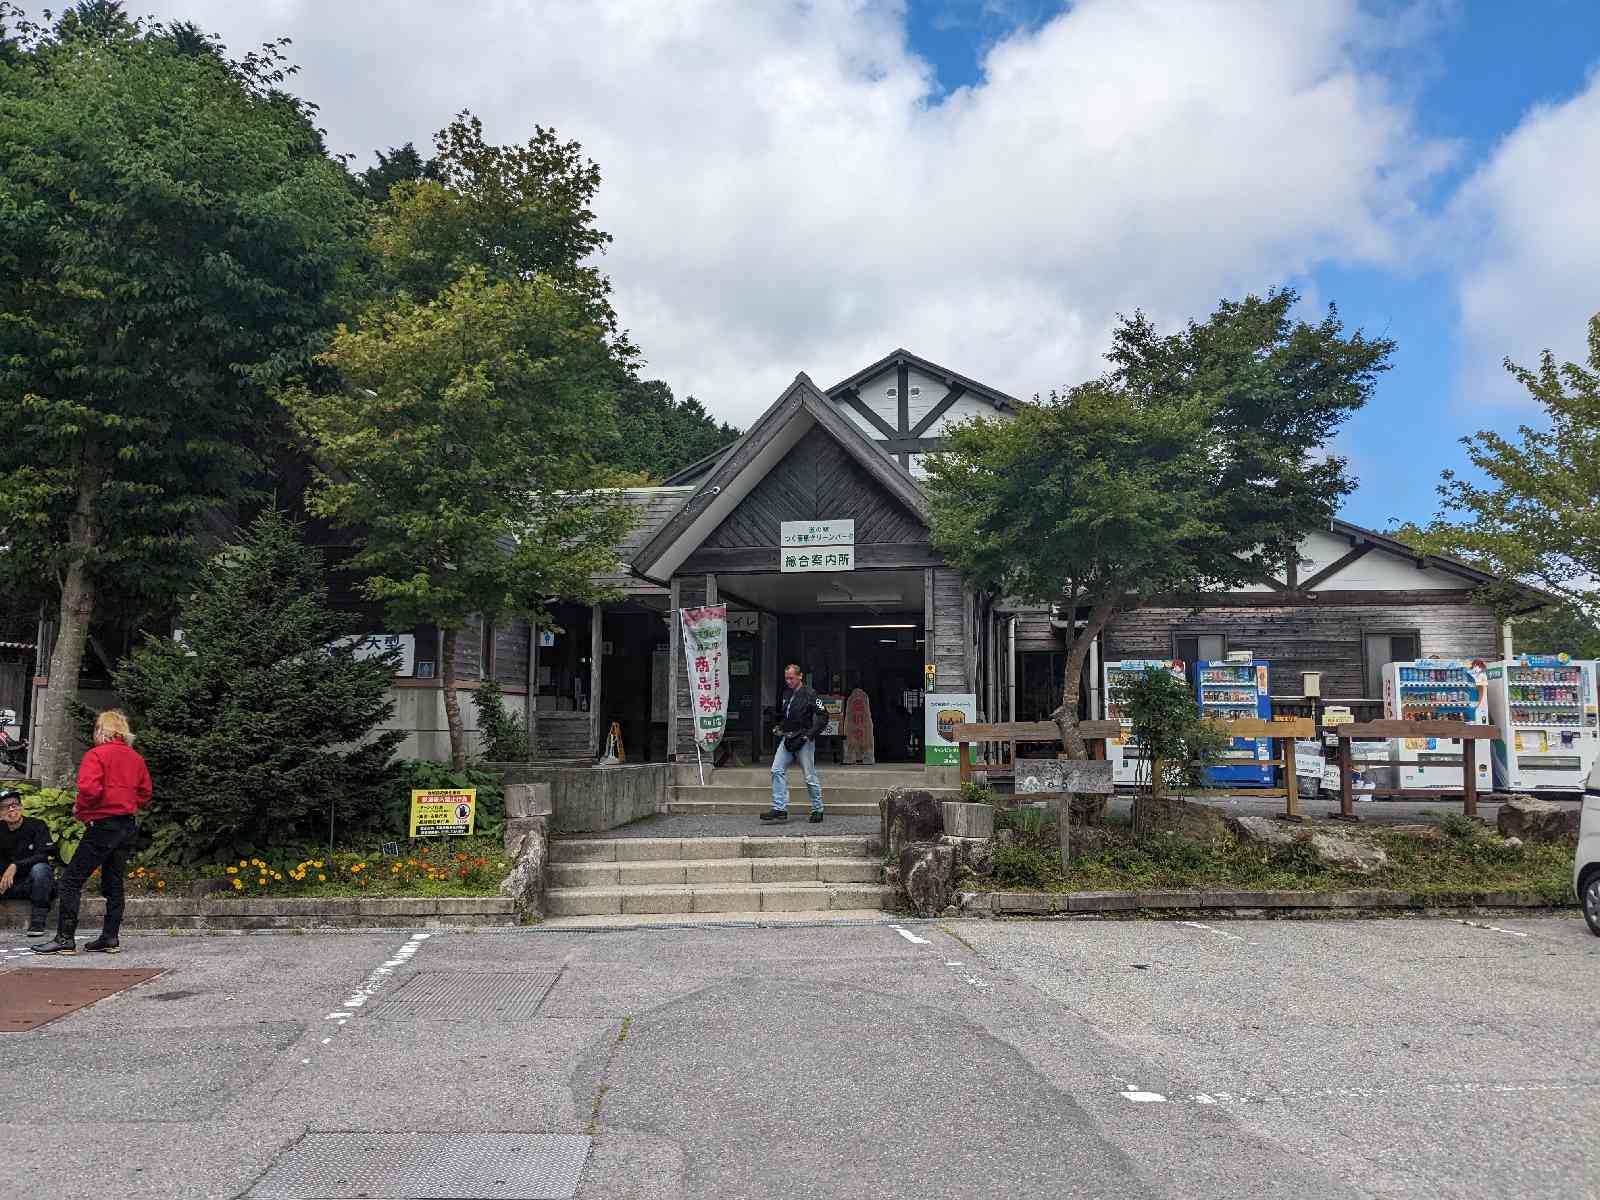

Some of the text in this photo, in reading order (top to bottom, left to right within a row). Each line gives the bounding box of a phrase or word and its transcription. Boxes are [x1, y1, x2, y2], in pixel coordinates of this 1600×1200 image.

[785, 553, 849, 567] 総合案内所
